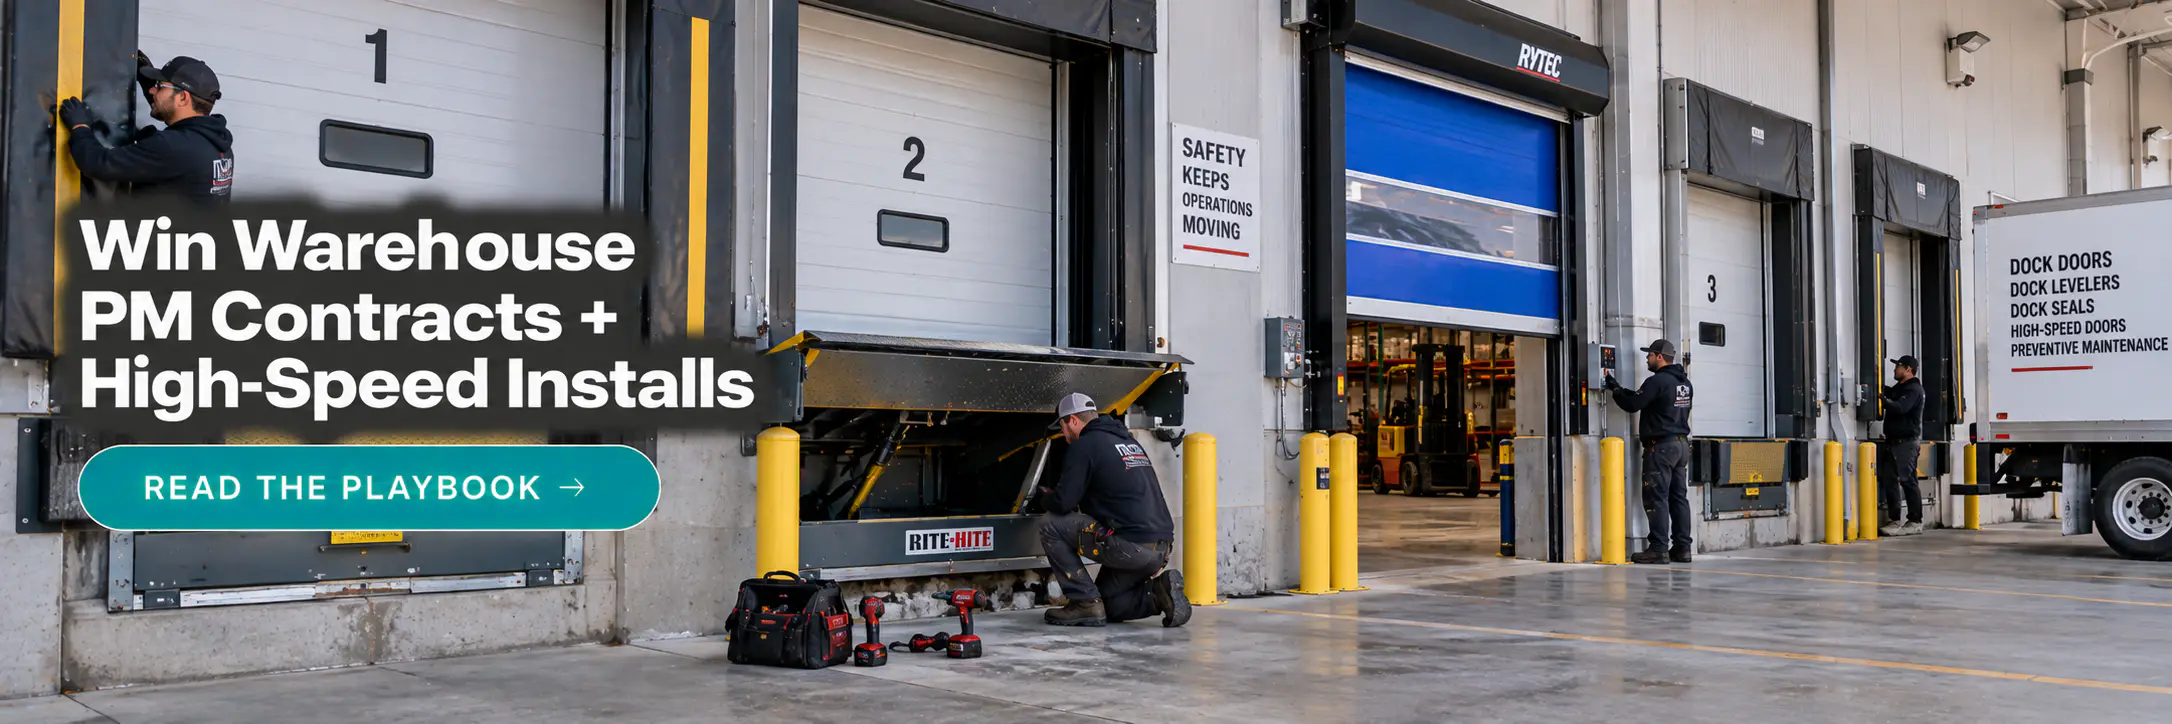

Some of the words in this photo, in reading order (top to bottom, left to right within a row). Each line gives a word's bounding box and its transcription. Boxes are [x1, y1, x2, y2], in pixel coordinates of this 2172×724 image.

[364, 28, 388, 85] 1
[1517, 42, 1562, 78] RYTEC
[902, 136, 926, 182] 2
[1182, 137, 1246, 168] SAFETY
[1182, 165, 1230, 191] KEEPS
[1182, 192, 1253, 217] OPERATIONS
[1182, 214, 1241, 240] MOVING
[2010, 255, 2053, 275] DOCK
[2058, 250, 2113, 272] DOORS
[1706, 274, 1718, 304] 3
[2010, 280, 2048, 298] DOCK
[2052, 274, 2120, 294] LEVELERS
[2010, 301, 2048, 318] DOCK
[2052, 298, 2095, 316] SEALS
[2011, 320, 2082, 339] HIGH-SPEED
[2085, 318, 2127, 334] DOORS
[2011, 340, 2079, 358] PREVENTIVE
[2082, 336, 2169, 354] MAINTENANCE
